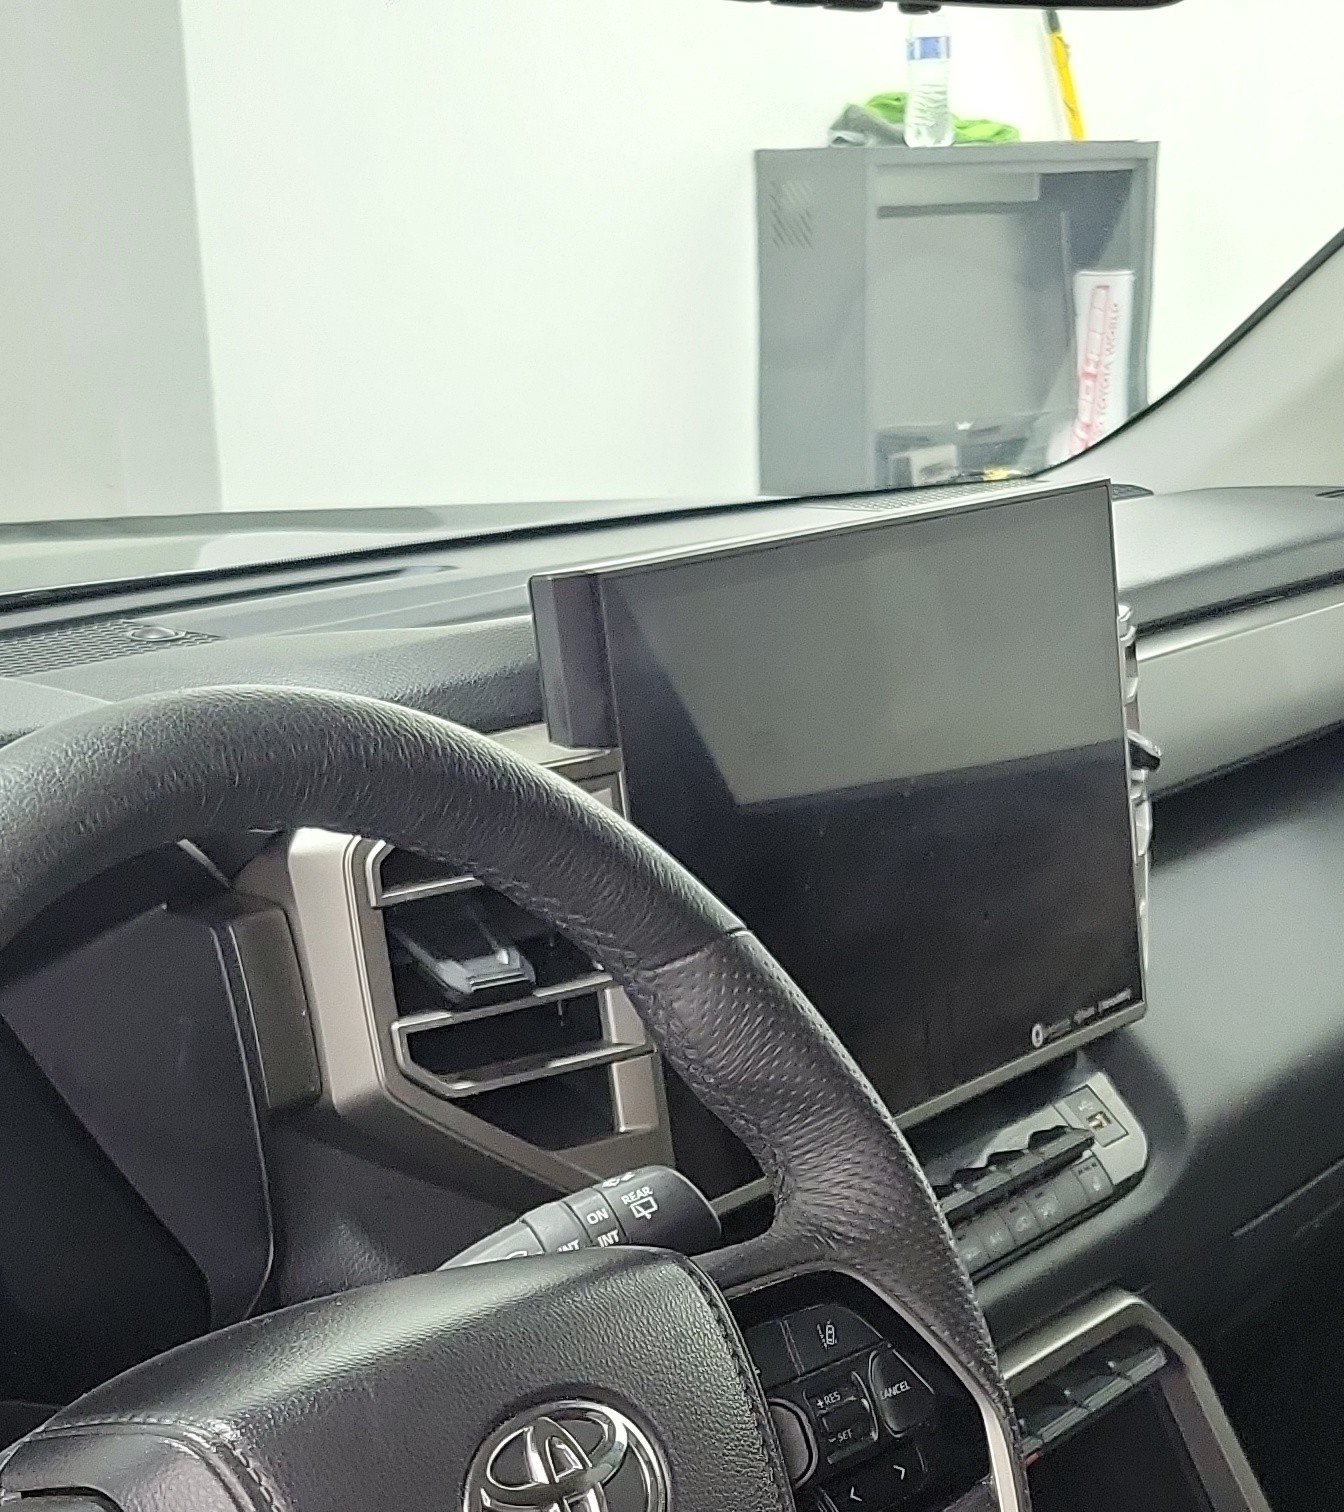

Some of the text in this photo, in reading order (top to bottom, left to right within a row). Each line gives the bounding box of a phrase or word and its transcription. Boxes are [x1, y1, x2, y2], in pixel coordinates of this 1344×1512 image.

[622, 1186, 653, 1205] REAR
[587, 1208, 609, 1225] ON
[597, 1229, 619, 1248] INT
